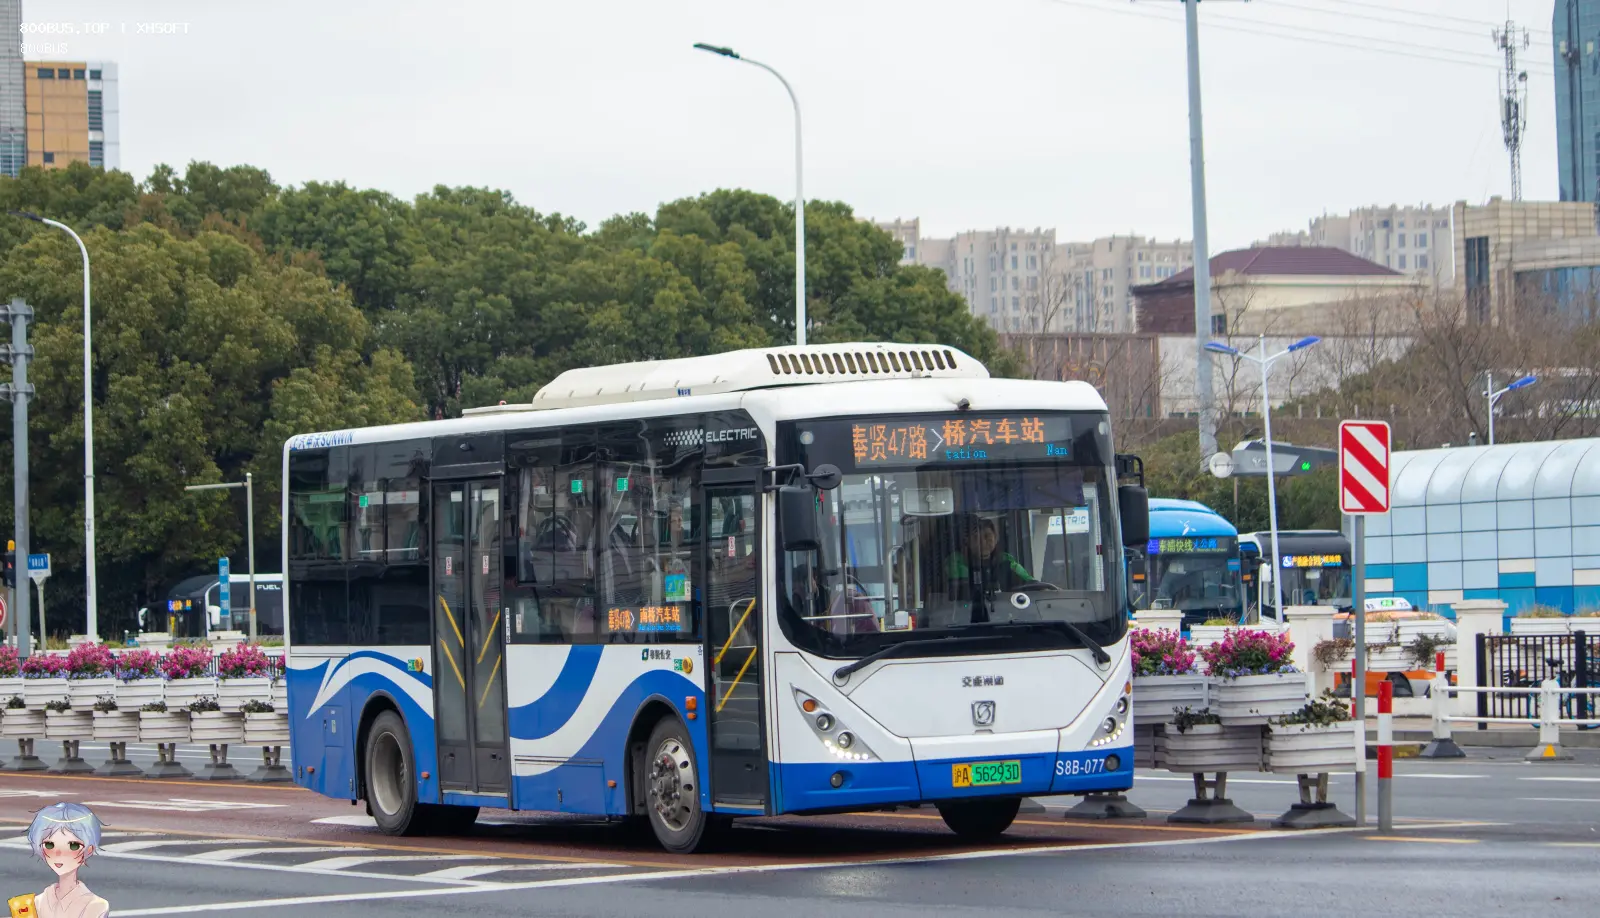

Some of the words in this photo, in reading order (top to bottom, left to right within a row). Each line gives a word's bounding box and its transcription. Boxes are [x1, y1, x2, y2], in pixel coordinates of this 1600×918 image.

[705, 427, 758, 443] ELECTRIC
[852, 423, 928, 463] 奉贤47路
[942, 417, 1045, 446] 桥汽车站
[946, 447, 988, 460] tation
[1046, 443, 1068, 456] Nan
[1050, 515, 1088, 527] LETRIC
[1055, 758, 1105, 776] S8B-077
